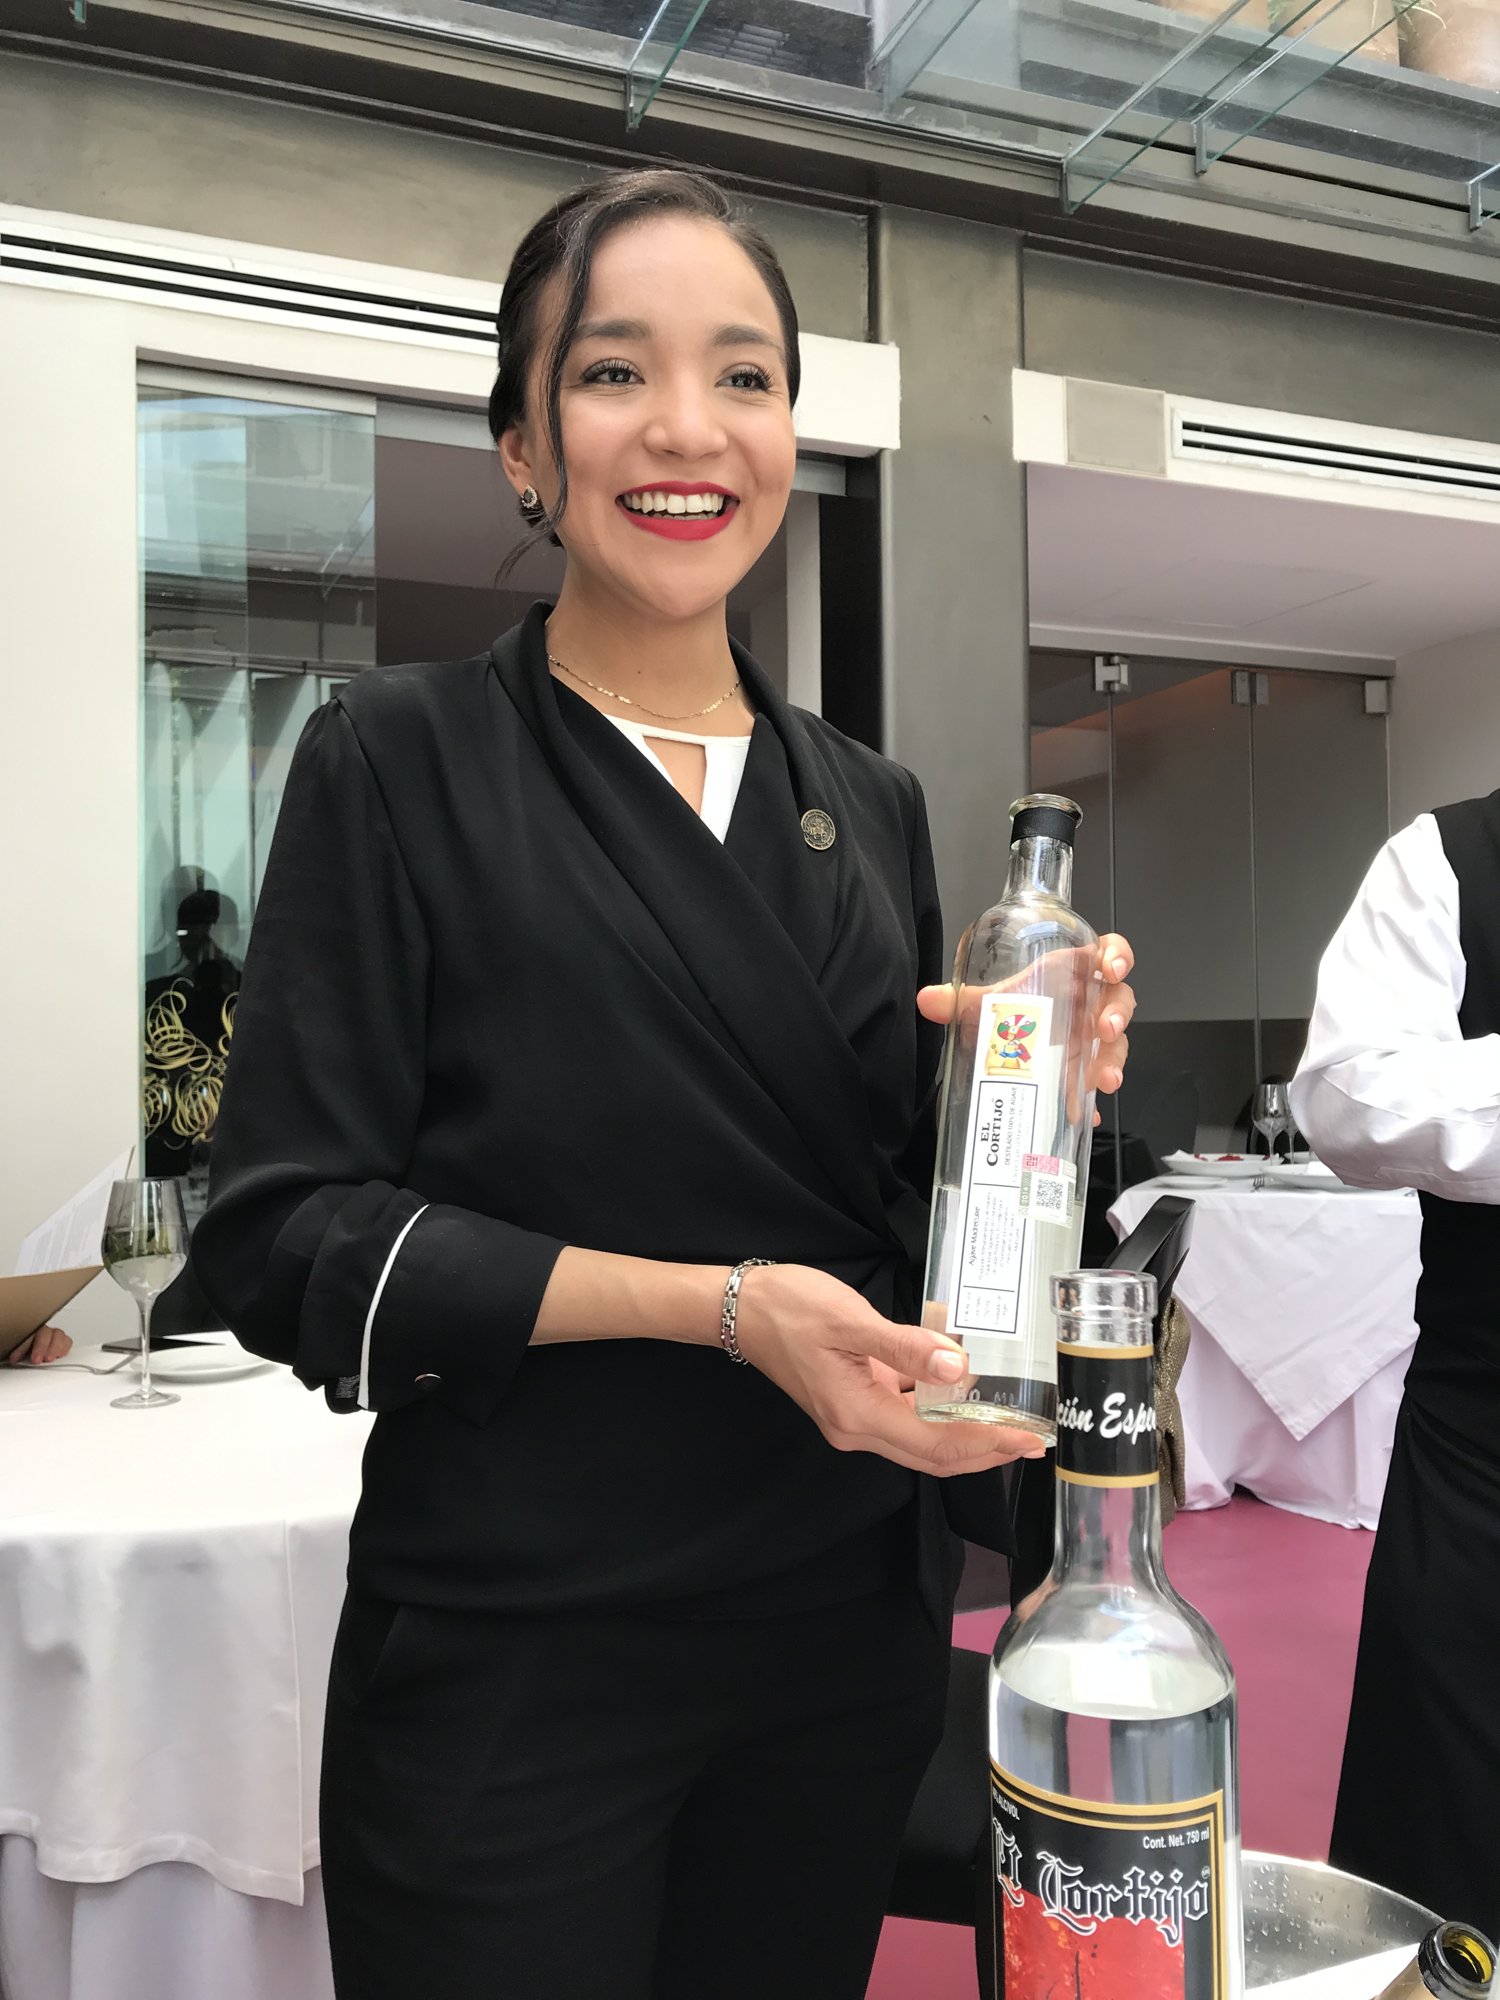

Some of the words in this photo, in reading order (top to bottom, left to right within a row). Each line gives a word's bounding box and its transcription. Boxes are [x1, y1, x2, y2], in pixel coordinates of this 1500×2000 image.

[980, 1122, 991, 1142] EL
[986, 1098, 1004, 1167] CORTIJO
[1004, 1130, 1014, 1166] DESTILADO
[1010, 1086, 1018, 1106] AGAVE
[968, 1244, 979, 1266] Agave
[1142, 1835, 1167, 1849] Cont.
[1168, 1834, 1185, 1848] Net.
[1186, 1829, 1200, 1845] 750
[1201, 1826, 1210, 1840] ml
[1037, 1850, 1209, 1948] Cortijo
